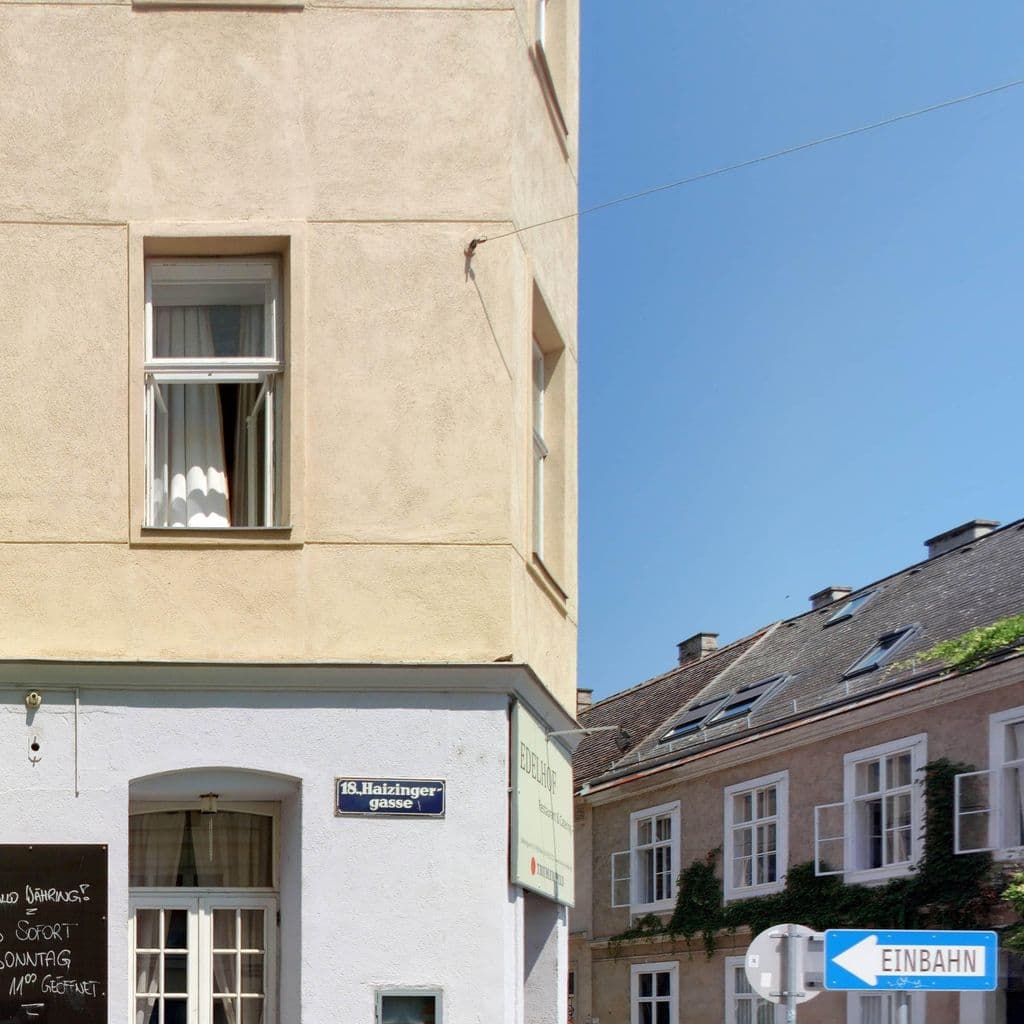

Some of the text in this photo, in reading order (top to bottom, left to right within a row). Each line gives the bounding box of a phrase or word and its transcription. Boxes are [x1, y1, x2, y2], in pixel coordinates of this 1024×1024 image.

[520, 741, 557, 795] EDELHOF
[369, 798, 413, 811] gasse
[15, 919, 79, 941] SOFORT
[881, 949, 977, 973] EINBAHN
